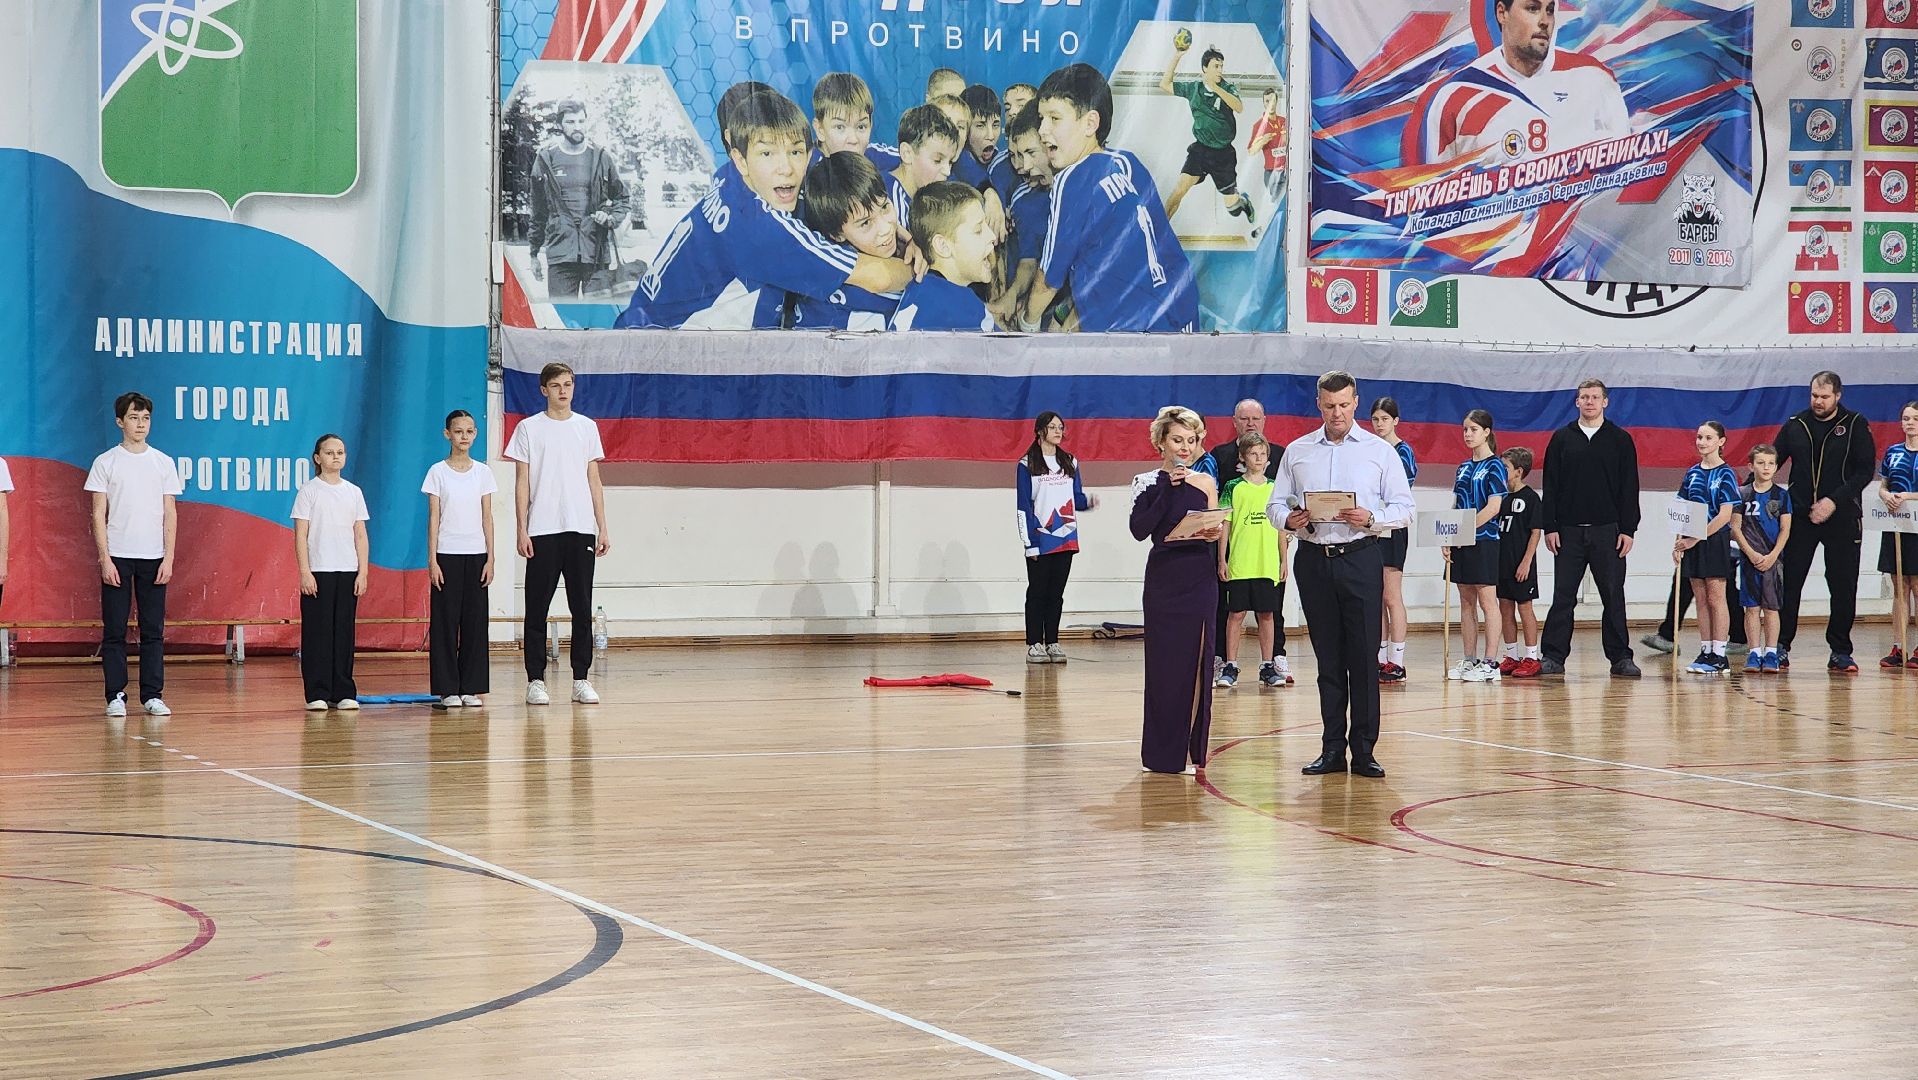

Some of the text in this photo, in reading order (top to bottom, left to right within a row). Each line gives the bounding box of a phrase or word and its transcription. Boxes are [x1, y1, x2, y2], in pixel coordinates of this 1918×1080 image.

[735, 16, 1080, 55] В ПРОТВИНО
[1528, 119, 1549, 152] 8
[1385, 129, 1669, 217] ТЫ ЖИВЁШЬ В СВОИХ УЧЕНИКАХ!
[1411, 161, 1667, 233] Команда памяти Иванова Сергея Геннадьевича
[1679, 223, 1718, 242] БАРСЫ
[1669, 248, 1691, 265] 2011
[1706, 249, 1734, 266] 2014
[95, 317, 362, 361] АДМИНИСТРАЦИЯ
[175, 386, 290, 426] ГОРОДА
[177, 457, 311, 491] РОТВИНО
[1667, 508, 1690, 523] Чехов
[1744, 501, 1760, 516] 22
[1435, 520, 1458, 536] Москва
